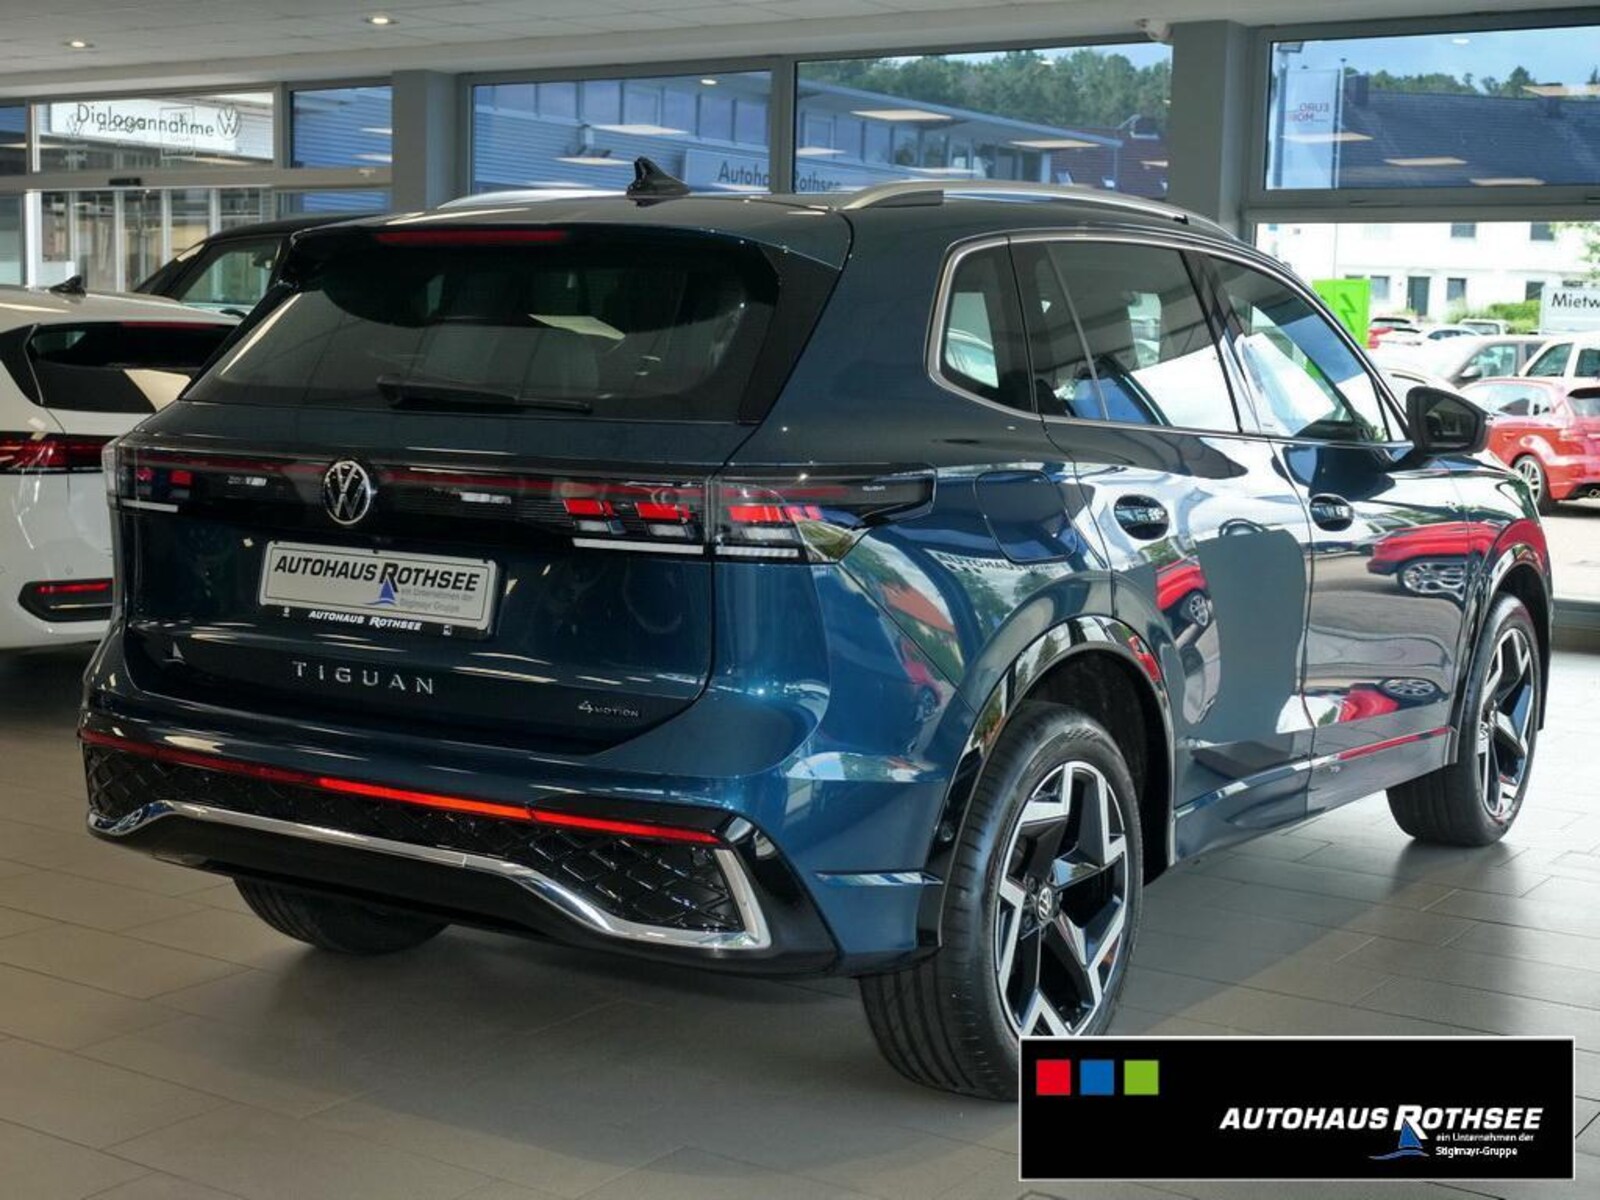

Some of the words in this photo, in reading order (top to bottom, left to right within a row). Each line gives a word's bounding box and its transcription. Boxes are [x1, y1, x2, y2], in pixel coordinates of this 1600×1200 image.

[76, 104, 215, 136] Dialogannahme
[1551, 292, 1600, 308] Mietw
[274, 555, 378, 581] AUTOHAUS
[379, 562, 480, 593] ROTHSEE
[308, 610, 365, 624] AUTOHAUS
[369, 616, 423, 631] ROTHSEE
[292, 661, 434, 694] TIGUAN
